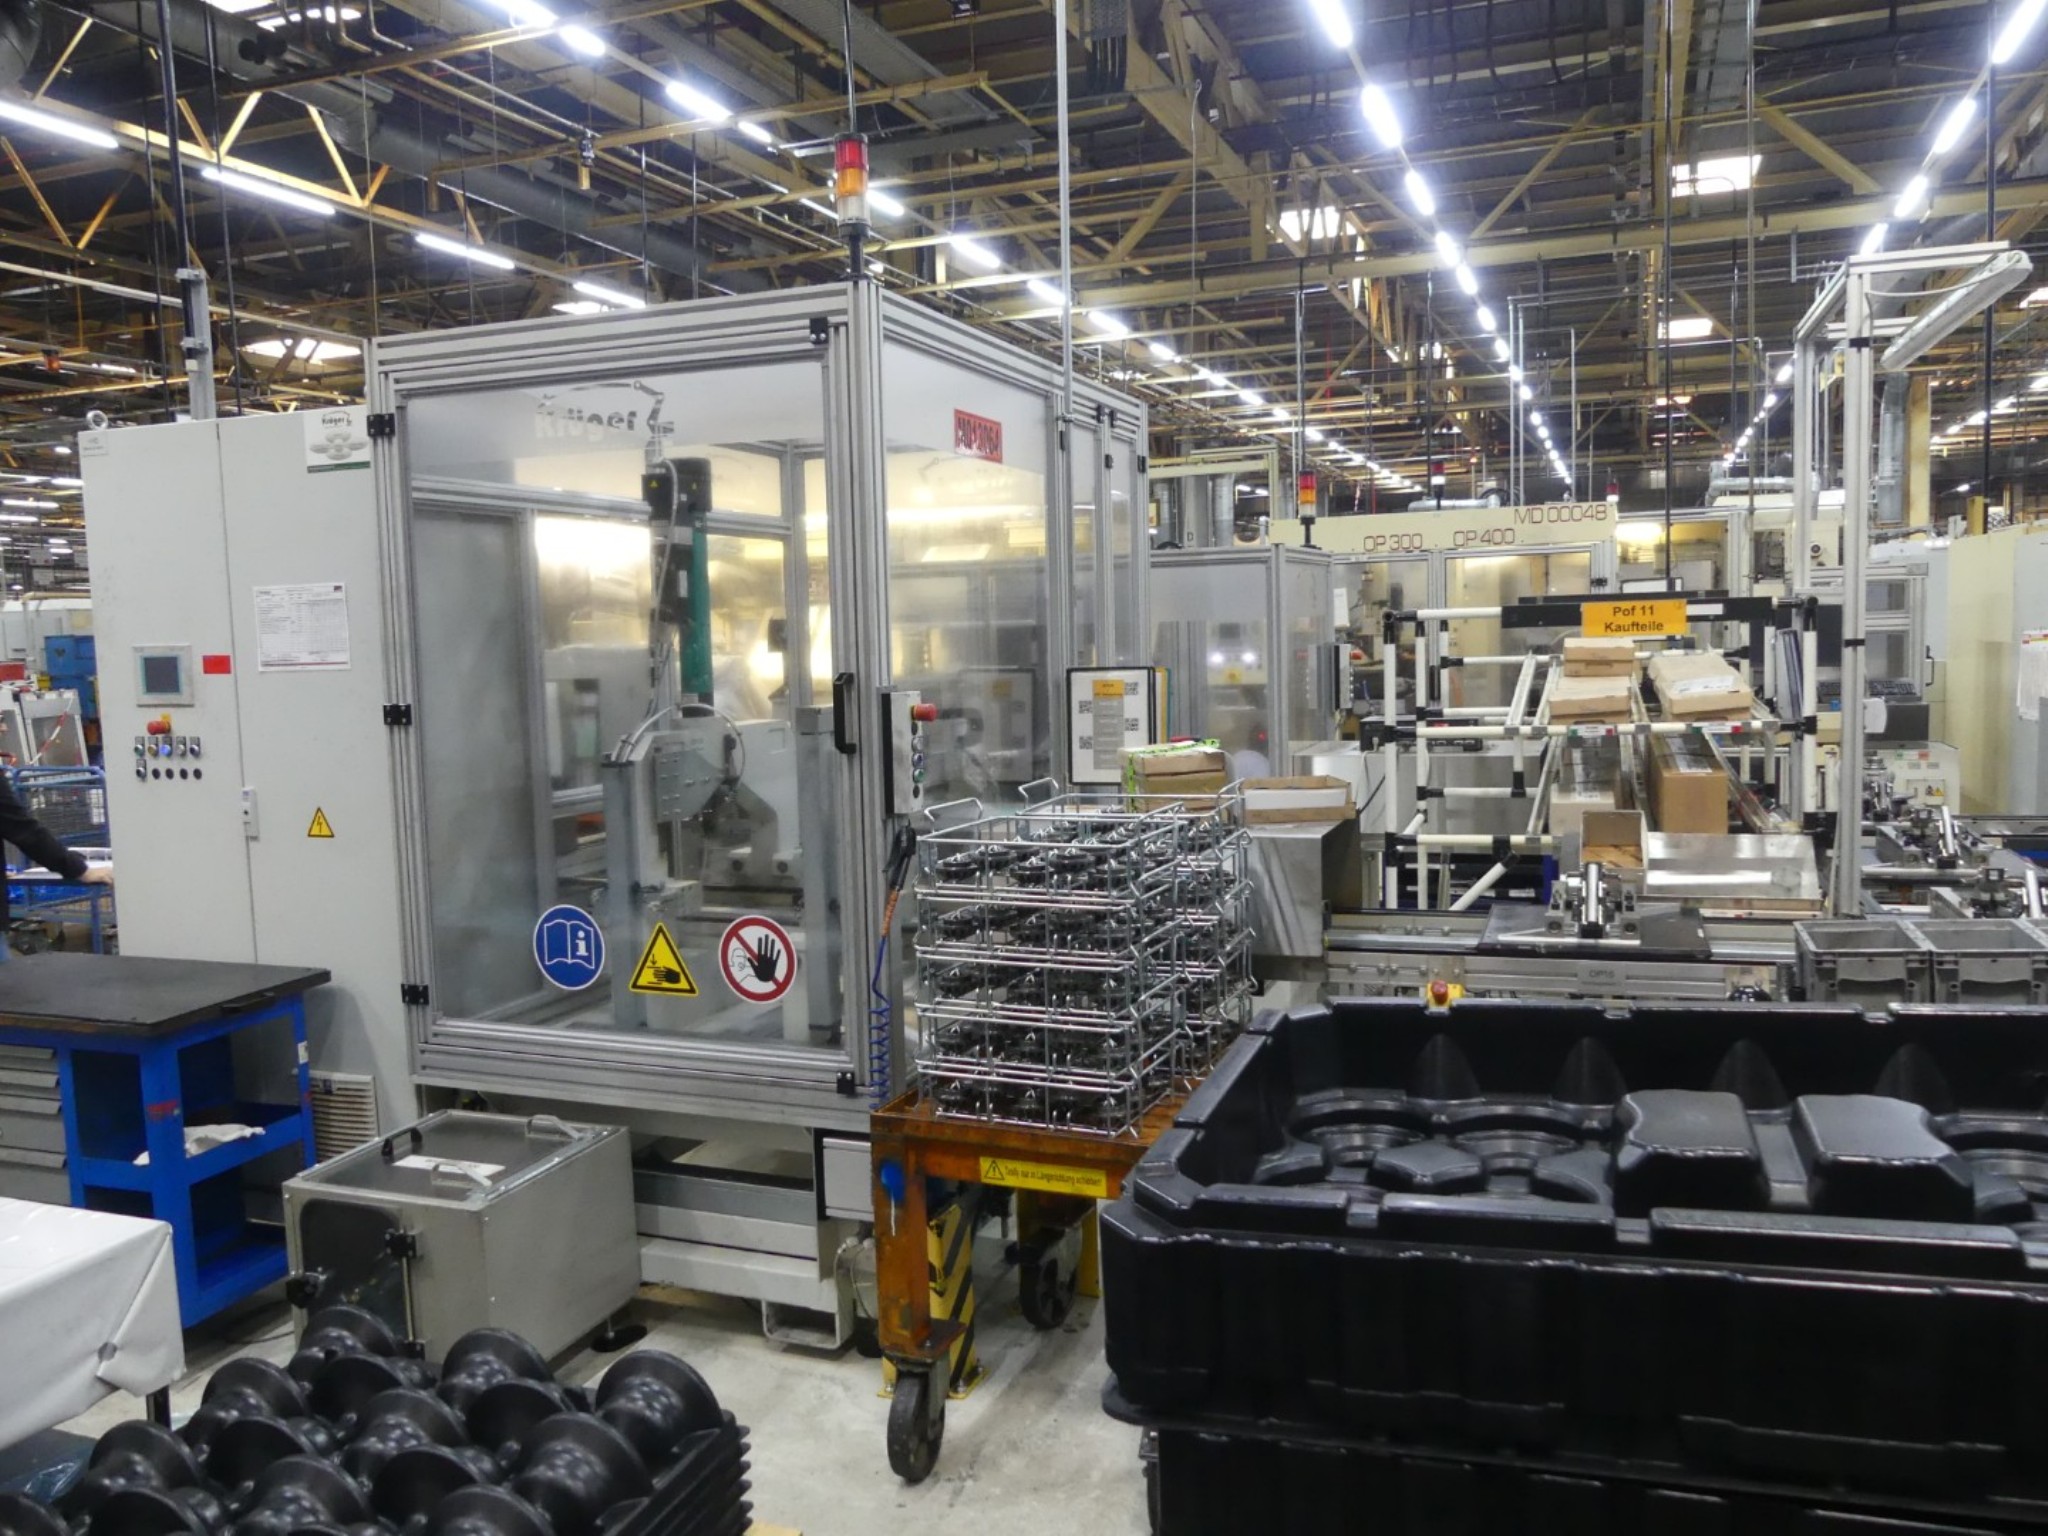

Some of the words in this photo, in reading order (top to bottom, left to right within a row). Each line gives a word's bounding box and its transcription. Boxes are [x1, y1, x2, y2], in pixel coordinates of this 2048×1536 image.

[1514, 507, 1543, 525] MD
[1547, 504, 1608, 524] 00048
[1364, 535, 1387, 553] OP
[1389, 533, 1423, 551] 300
[1453, 530, 1478, 548] OP
[1481, 528, 1516, 546] 400
[1613, 605, 1637, 617] Pof
[1641, 605, 1655, 616] 11
[1604, 621, 1665, 633] Kaufteile
